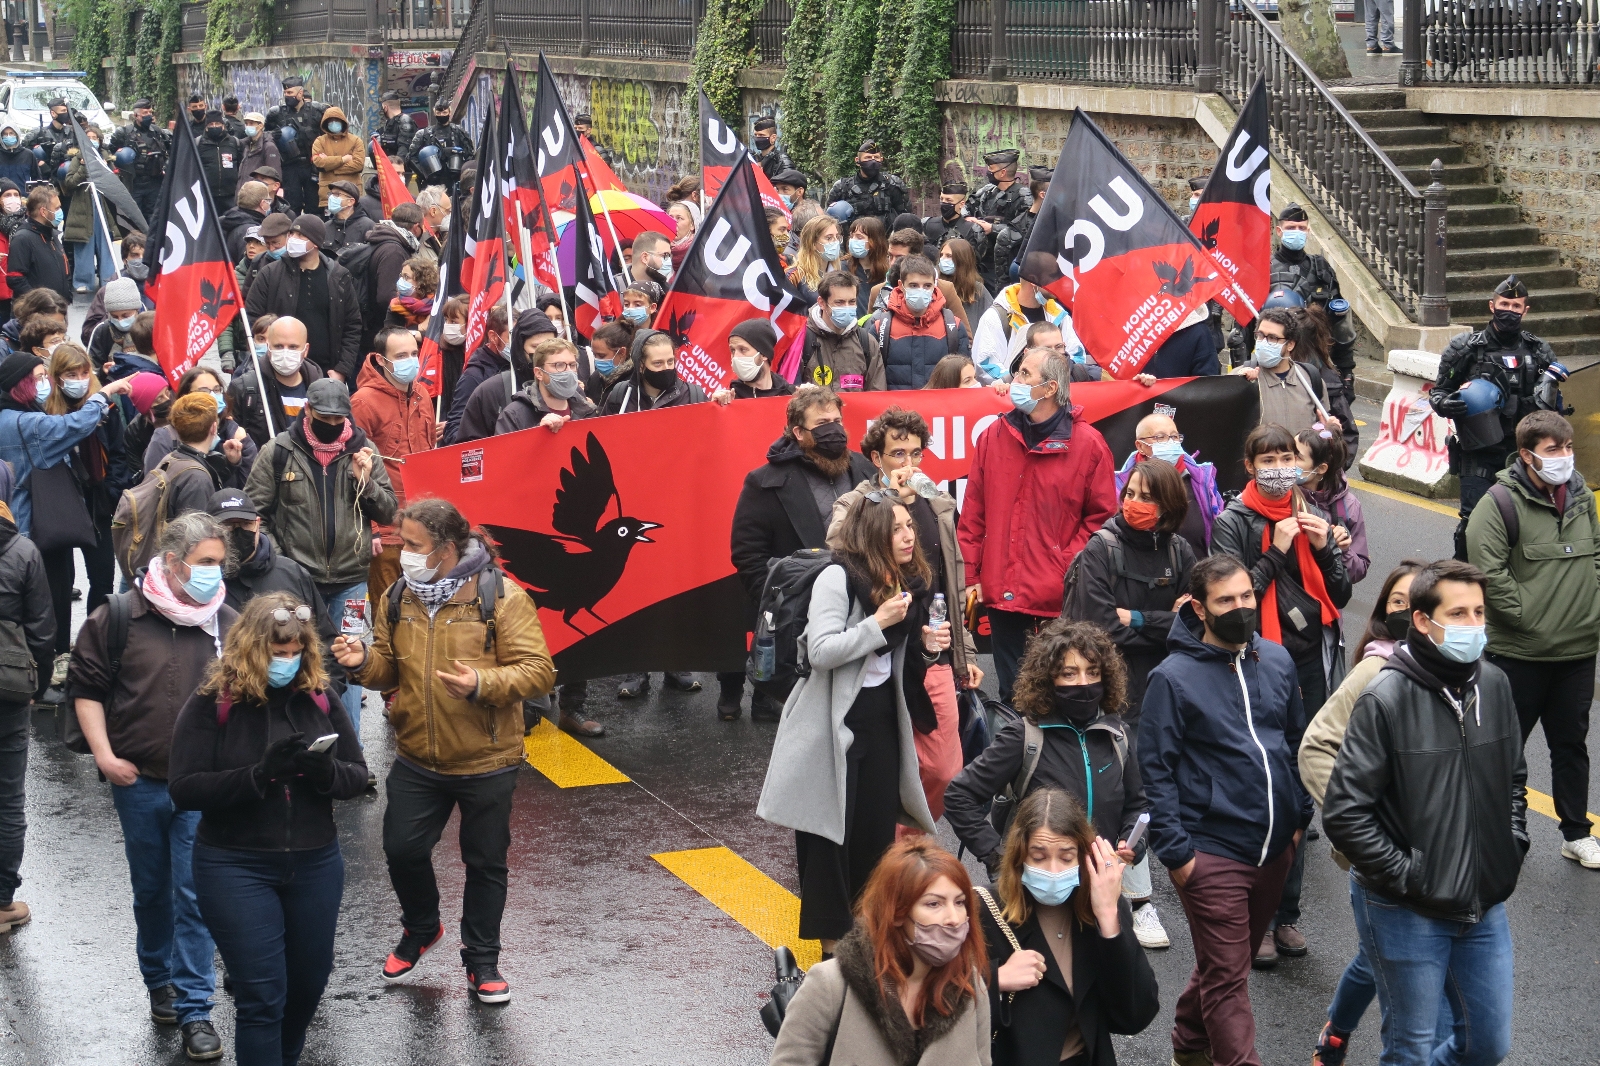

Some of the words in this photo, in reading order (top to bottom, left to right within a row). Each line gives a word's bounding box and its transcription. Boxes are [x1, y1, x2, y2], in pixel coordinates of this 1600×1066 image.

[759, 192, 781, 206] NION
[680, 350, 727, 392] COMMUN
[692, 344, 727, 380] UNION
